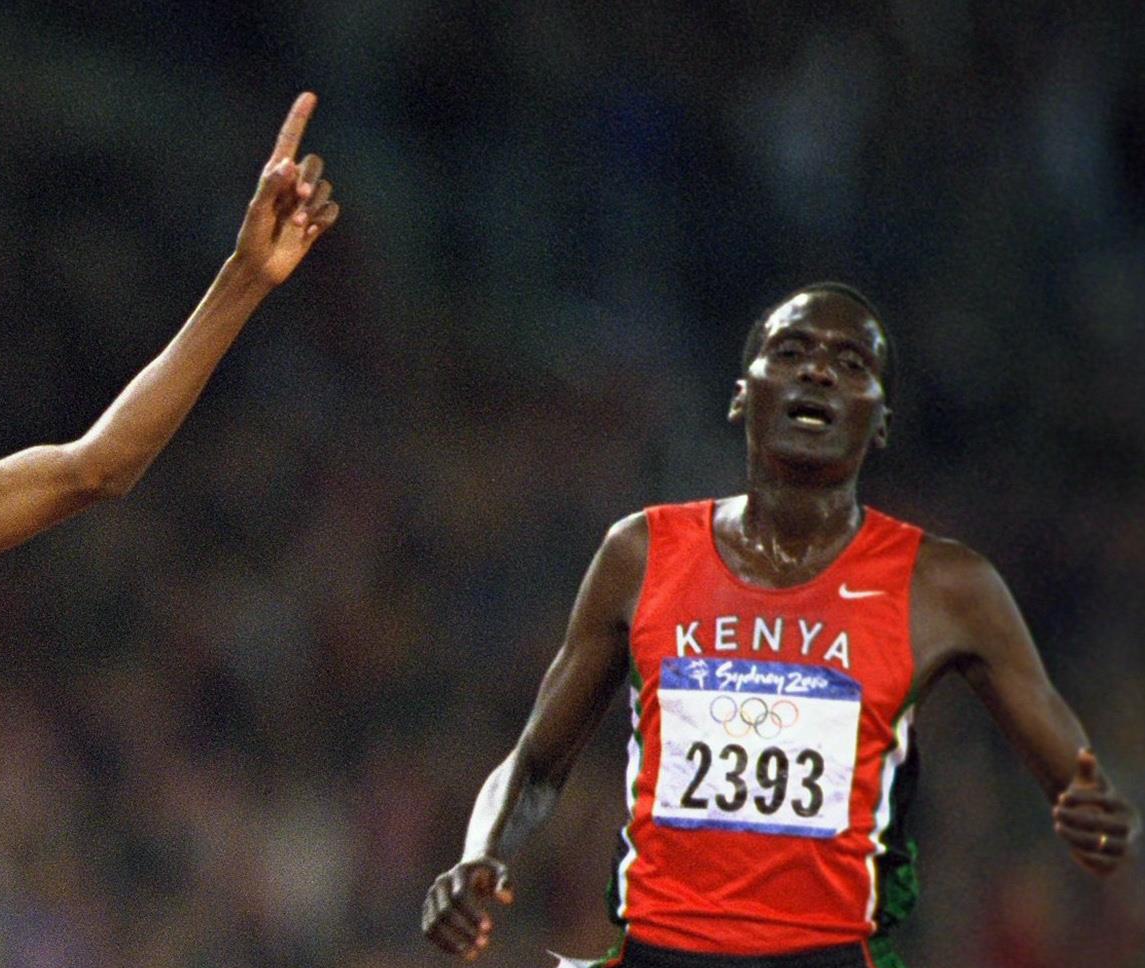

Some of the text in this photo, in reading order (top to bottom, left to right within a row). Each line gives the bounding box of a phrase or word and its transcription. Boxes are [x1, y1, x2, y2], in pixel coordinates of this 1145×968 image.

[675, 615, 851, 670] KENYA
[715, 660, 829, 695] Sydney 2000
[679, 741, 825, 818] 2393
